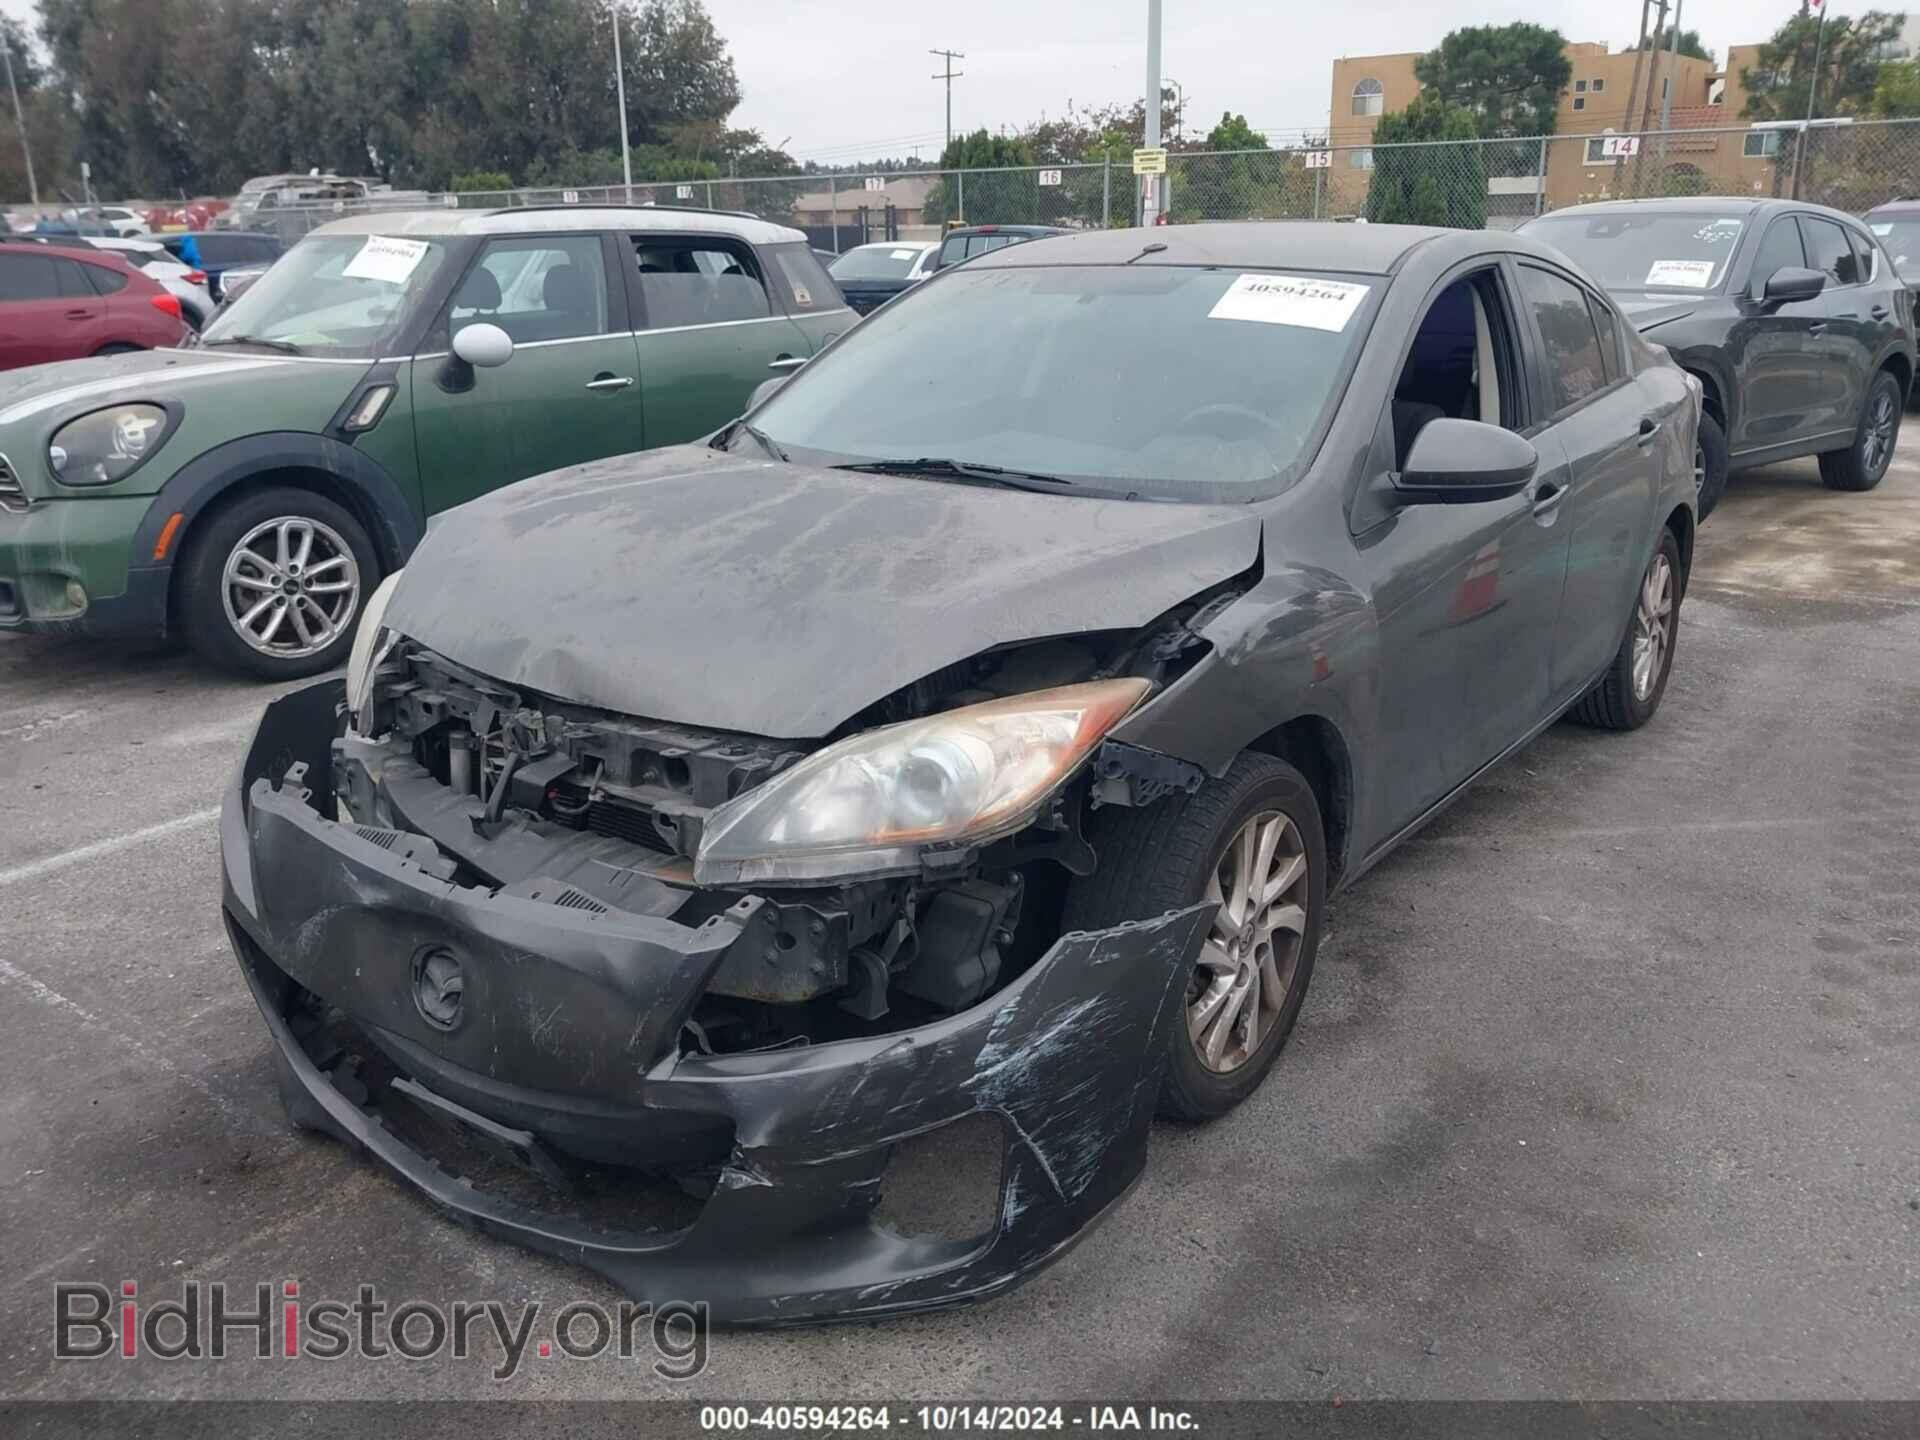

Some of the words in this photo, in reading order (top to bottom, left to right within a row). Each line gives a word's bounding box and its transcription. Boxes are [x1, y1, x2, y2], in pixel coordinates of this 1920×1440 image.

[1611, 138, 1632, 153] 14
[1311, 152, 1328, 166] 15
[1043, 171, 1058, 185] 16
[1246, 283, 1347, 301] 40594264
